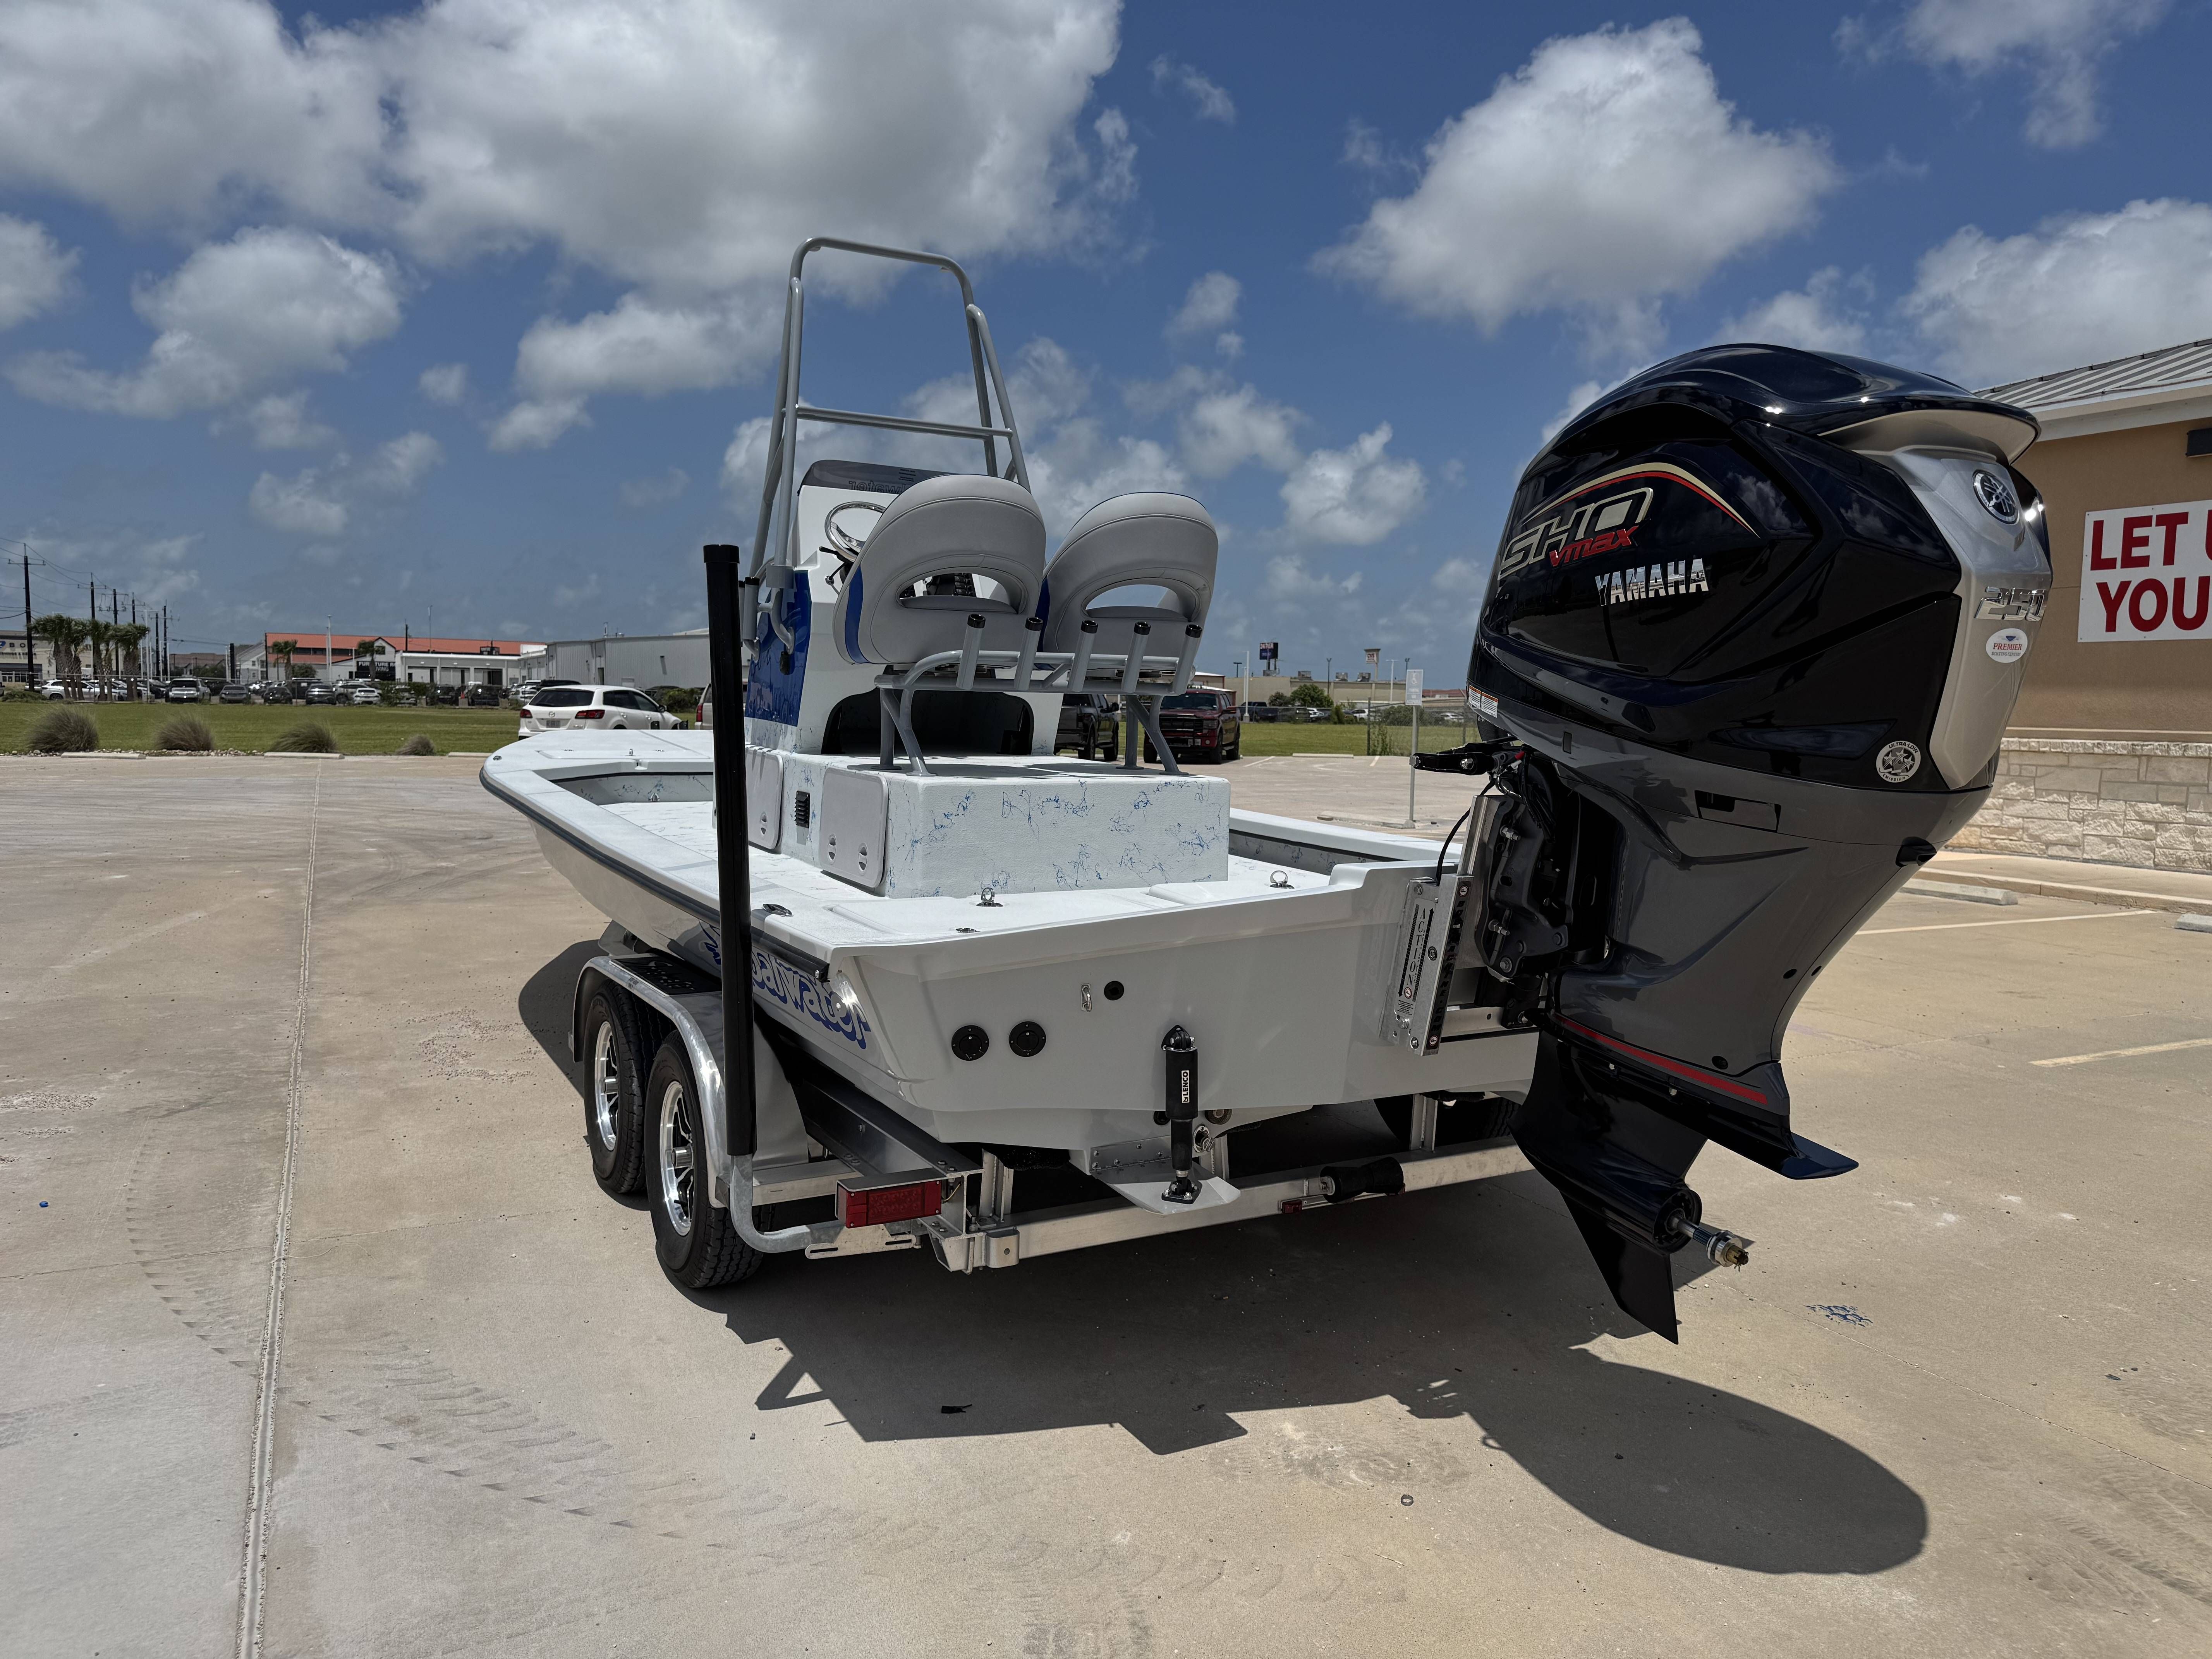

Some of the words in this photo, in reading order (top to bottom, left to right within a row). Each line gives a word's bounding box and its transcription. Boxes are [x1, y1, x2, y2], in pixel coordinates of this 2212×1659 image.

[1498, 487, 1654, 581] SHO
[2090, 512, 2189, 571] LET
[1595, 558, 1709, 606] YAMAHA
[1974, 586, 2049, 622] 250
[1407, 908, 1425, 986] ACTION
